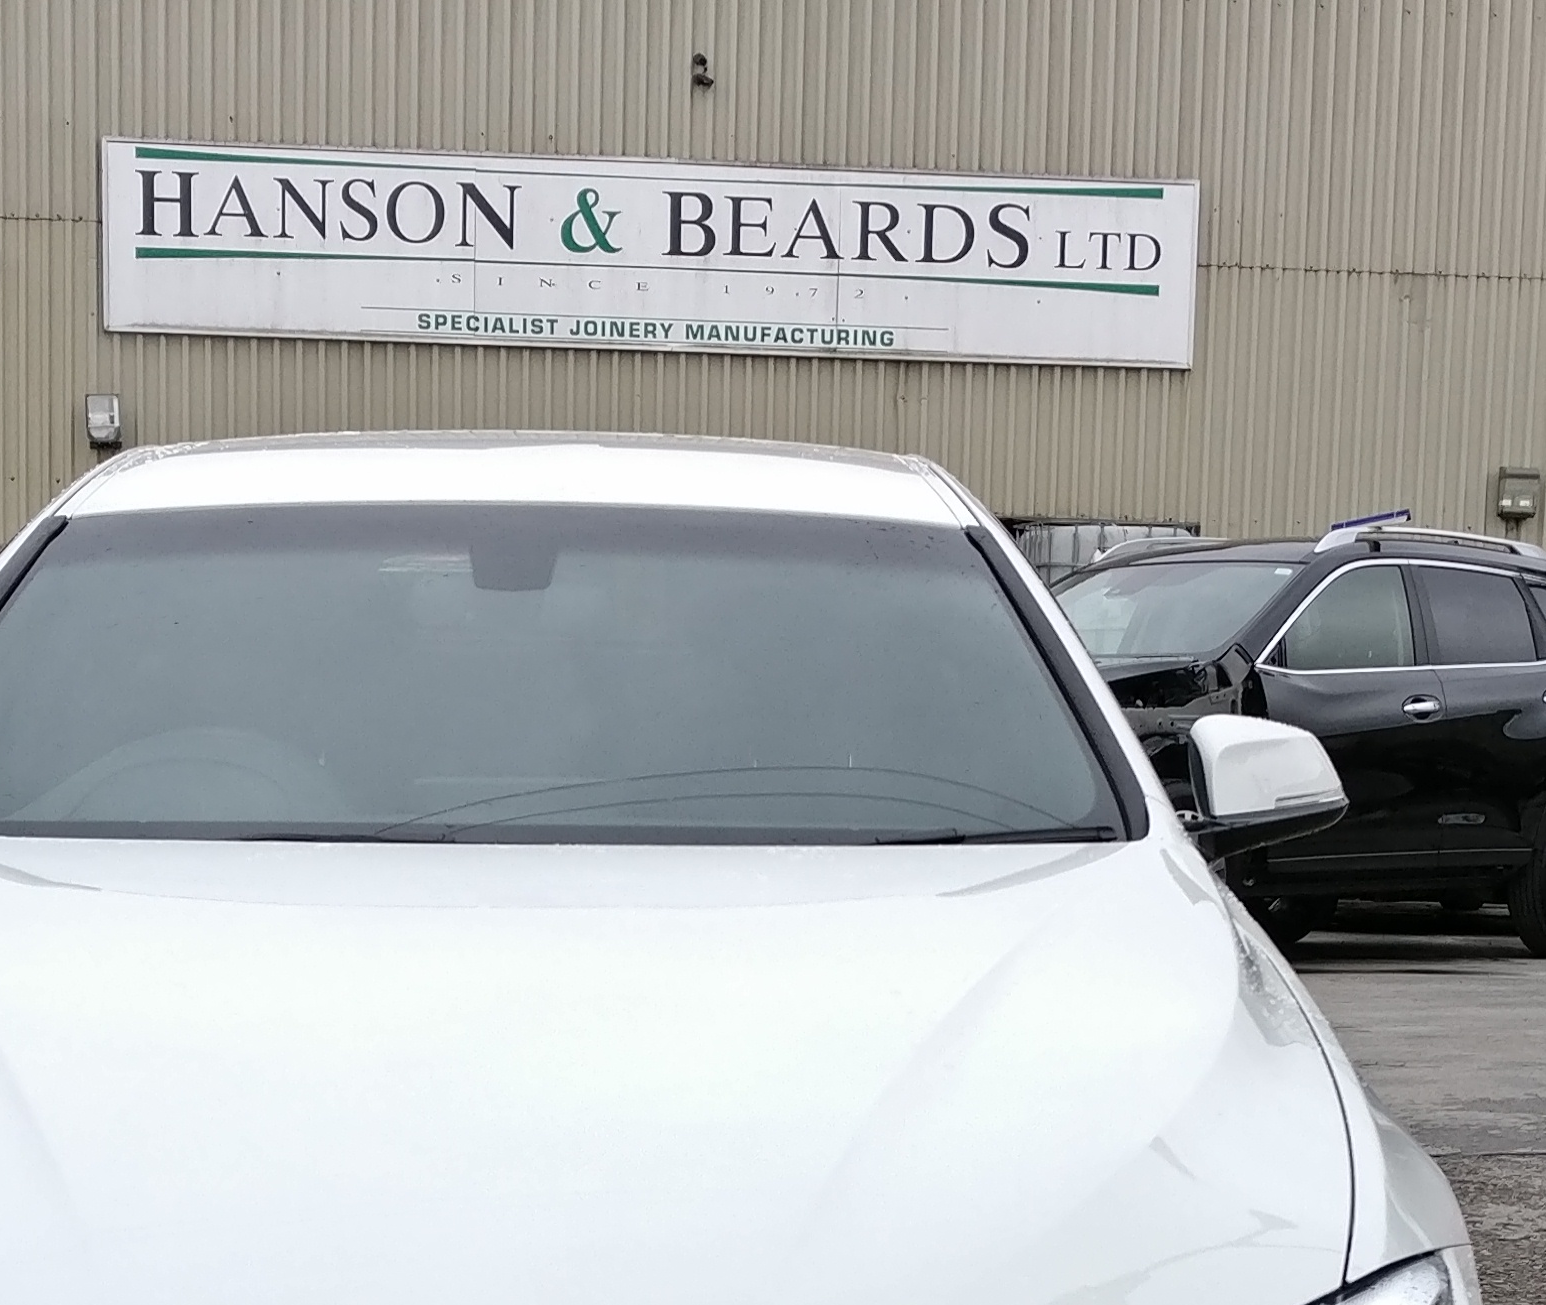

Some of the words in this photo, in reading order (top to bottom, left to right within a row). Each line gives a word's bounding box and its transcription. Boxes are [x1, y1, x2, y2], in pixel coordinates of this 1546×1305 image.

[134, 169, 523, 250] HANSON
[560, 187, 623, 253] &
[661, 190, 1031, 269] BEARDS
[1053, 229, 1163, 271] LTD
[450, 273, 650, 292] SINCE
[722, 283, 865, 300] 1972
[417, 313, 559, 336] SPECIALIST
[569, 319, 675, 341] JOINERY
[684, 322, 895, 347] MANUFACTURING
